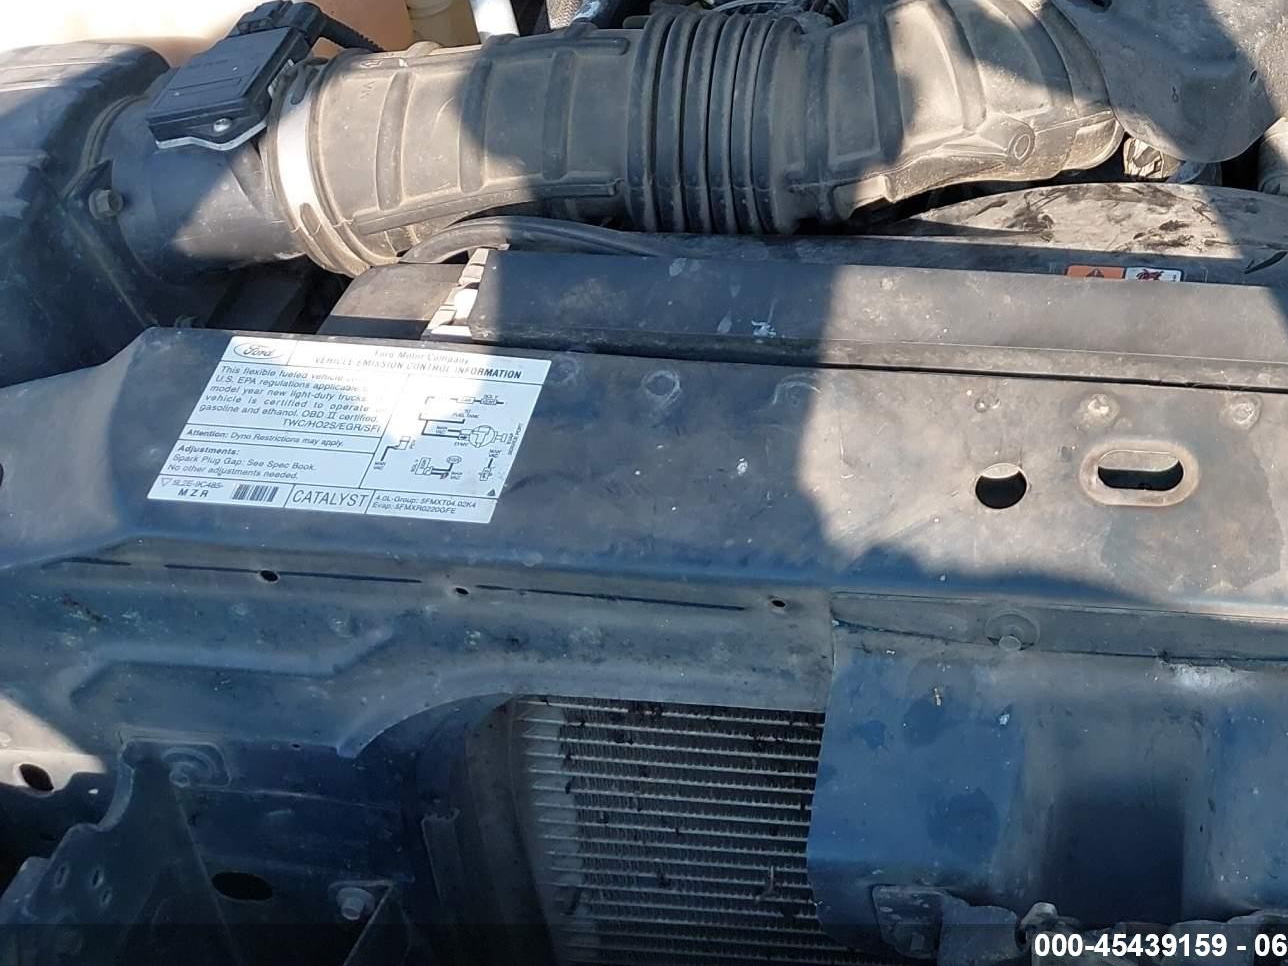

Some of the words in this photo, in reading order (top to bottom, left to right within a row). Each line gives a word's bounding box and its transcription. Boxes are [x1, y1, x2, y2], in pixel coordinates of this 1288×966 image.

[241, 344, 277, 357] Ford
[453, 366, 522, 378] INFORMATION
[213, 375, 236, 383] U.S.
[236, 376, 257, 384] EPA
[257, 378, 311, 390] regulations
[203, 393, 243, 403] vehicle
[262, 398, 308, 407] certified
[311, 401, 324, 409] to
[327, 403, 369, 413] operate
[198, 403, 240, 413] gasoline
[240, 406, 260, 414] and
[260, 407, 299, 417] ethanol.
[300, 409, 325, 418] OBD
[326, 411, 337, 419] II
[185, 429, 229, 438] Attention:
[228, 432, 252, 441] Dyno
[252, 433, 301, 443] Restrictions
[300, 438, 319, 446] may
[319, 438, 345, 448] apply.
[176, 444, 241, 456] Adjustments:
[181, 464, 206, 472] other
[205, 466, 262, 478] adjustments
[262, 470, 299, 479] needed.
[290, 489, 368, 507] CATALYST
